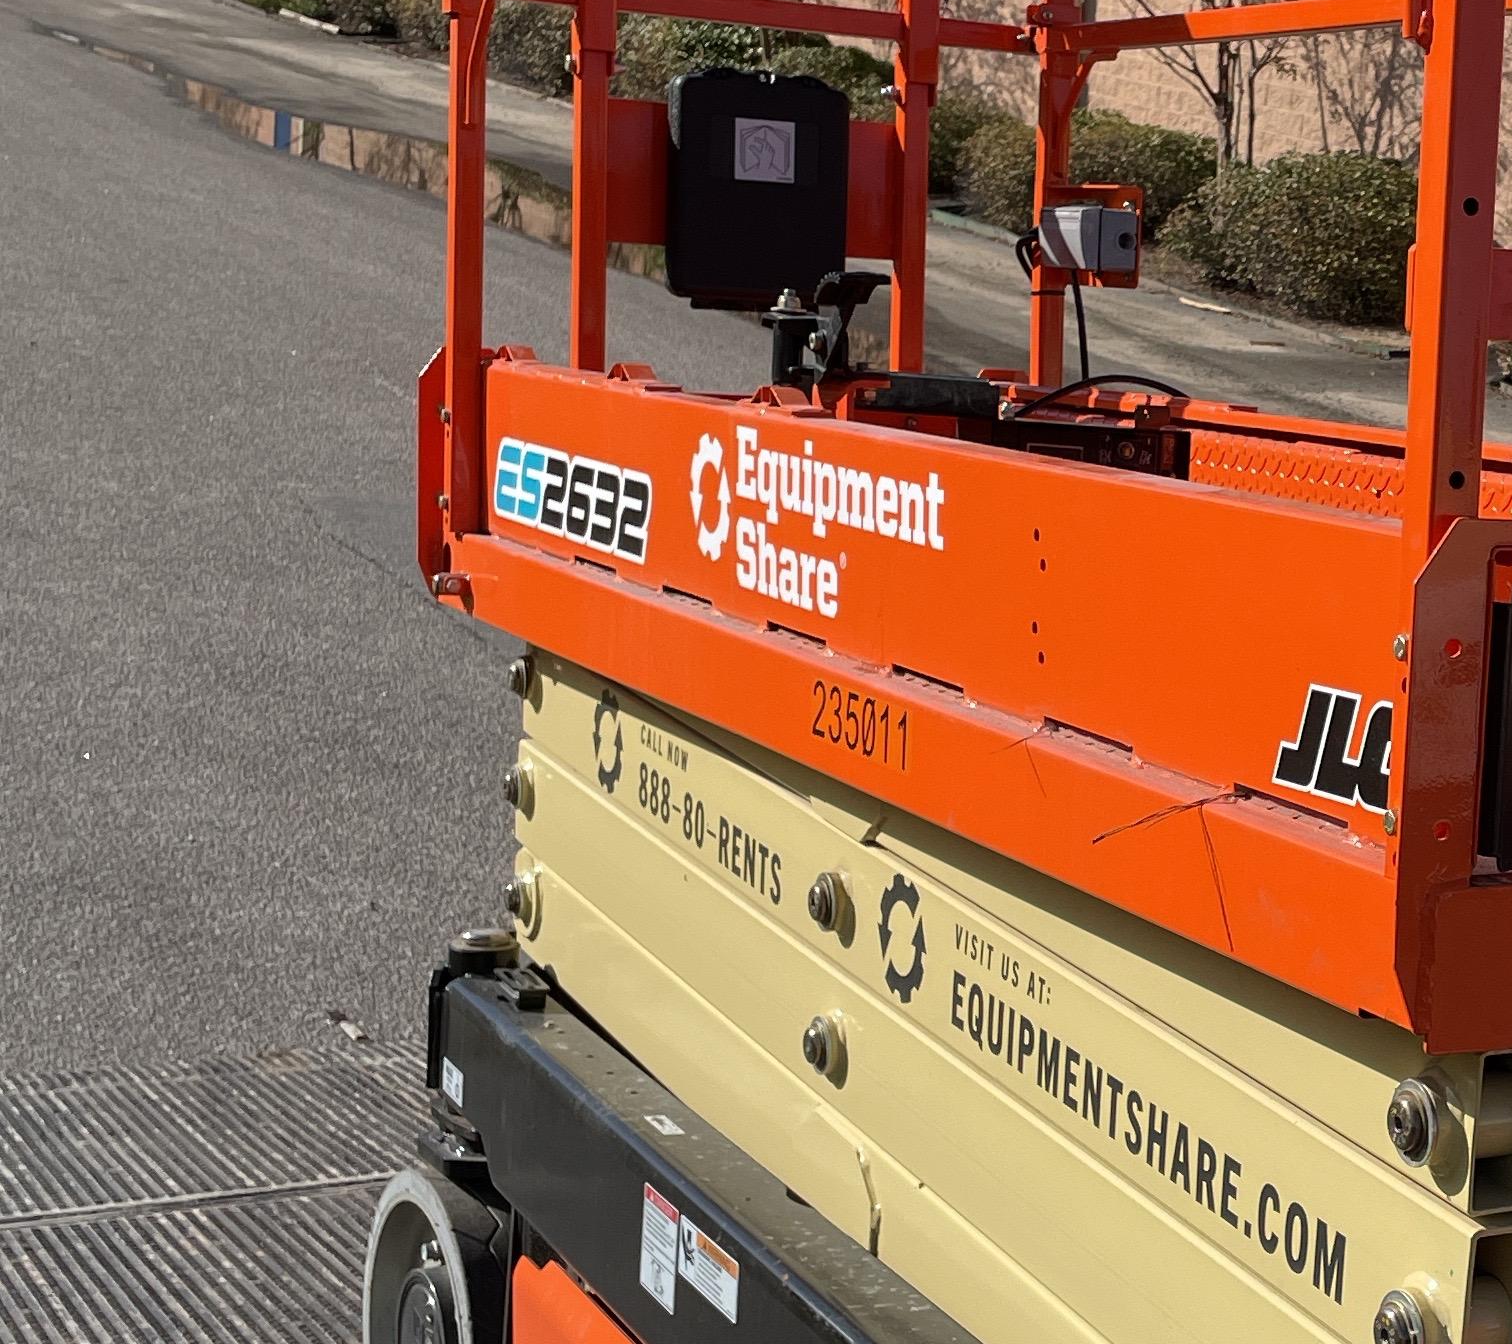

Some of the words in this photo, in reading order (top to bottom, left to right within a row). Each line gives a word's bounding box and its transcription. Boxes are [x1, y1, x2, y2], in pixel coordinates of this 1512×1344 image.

[494, 436, 653, 565] ES2632
[735, 425, 945, 551] Equipment
[735, 517, 840, 618] Share
[640, 723, 664, 759] CALL
[667, 740, 689, 774] NOW
[638, 761, 782, 907] 888-80-RENTS
[955, 923, 994, 972] VISIT
[1001, 950, 1020, 983] US
[1027, 971, 1052, 1007] AT:
[951, 969, 1347, 1307] EQUIPMENTSHARE.COM
